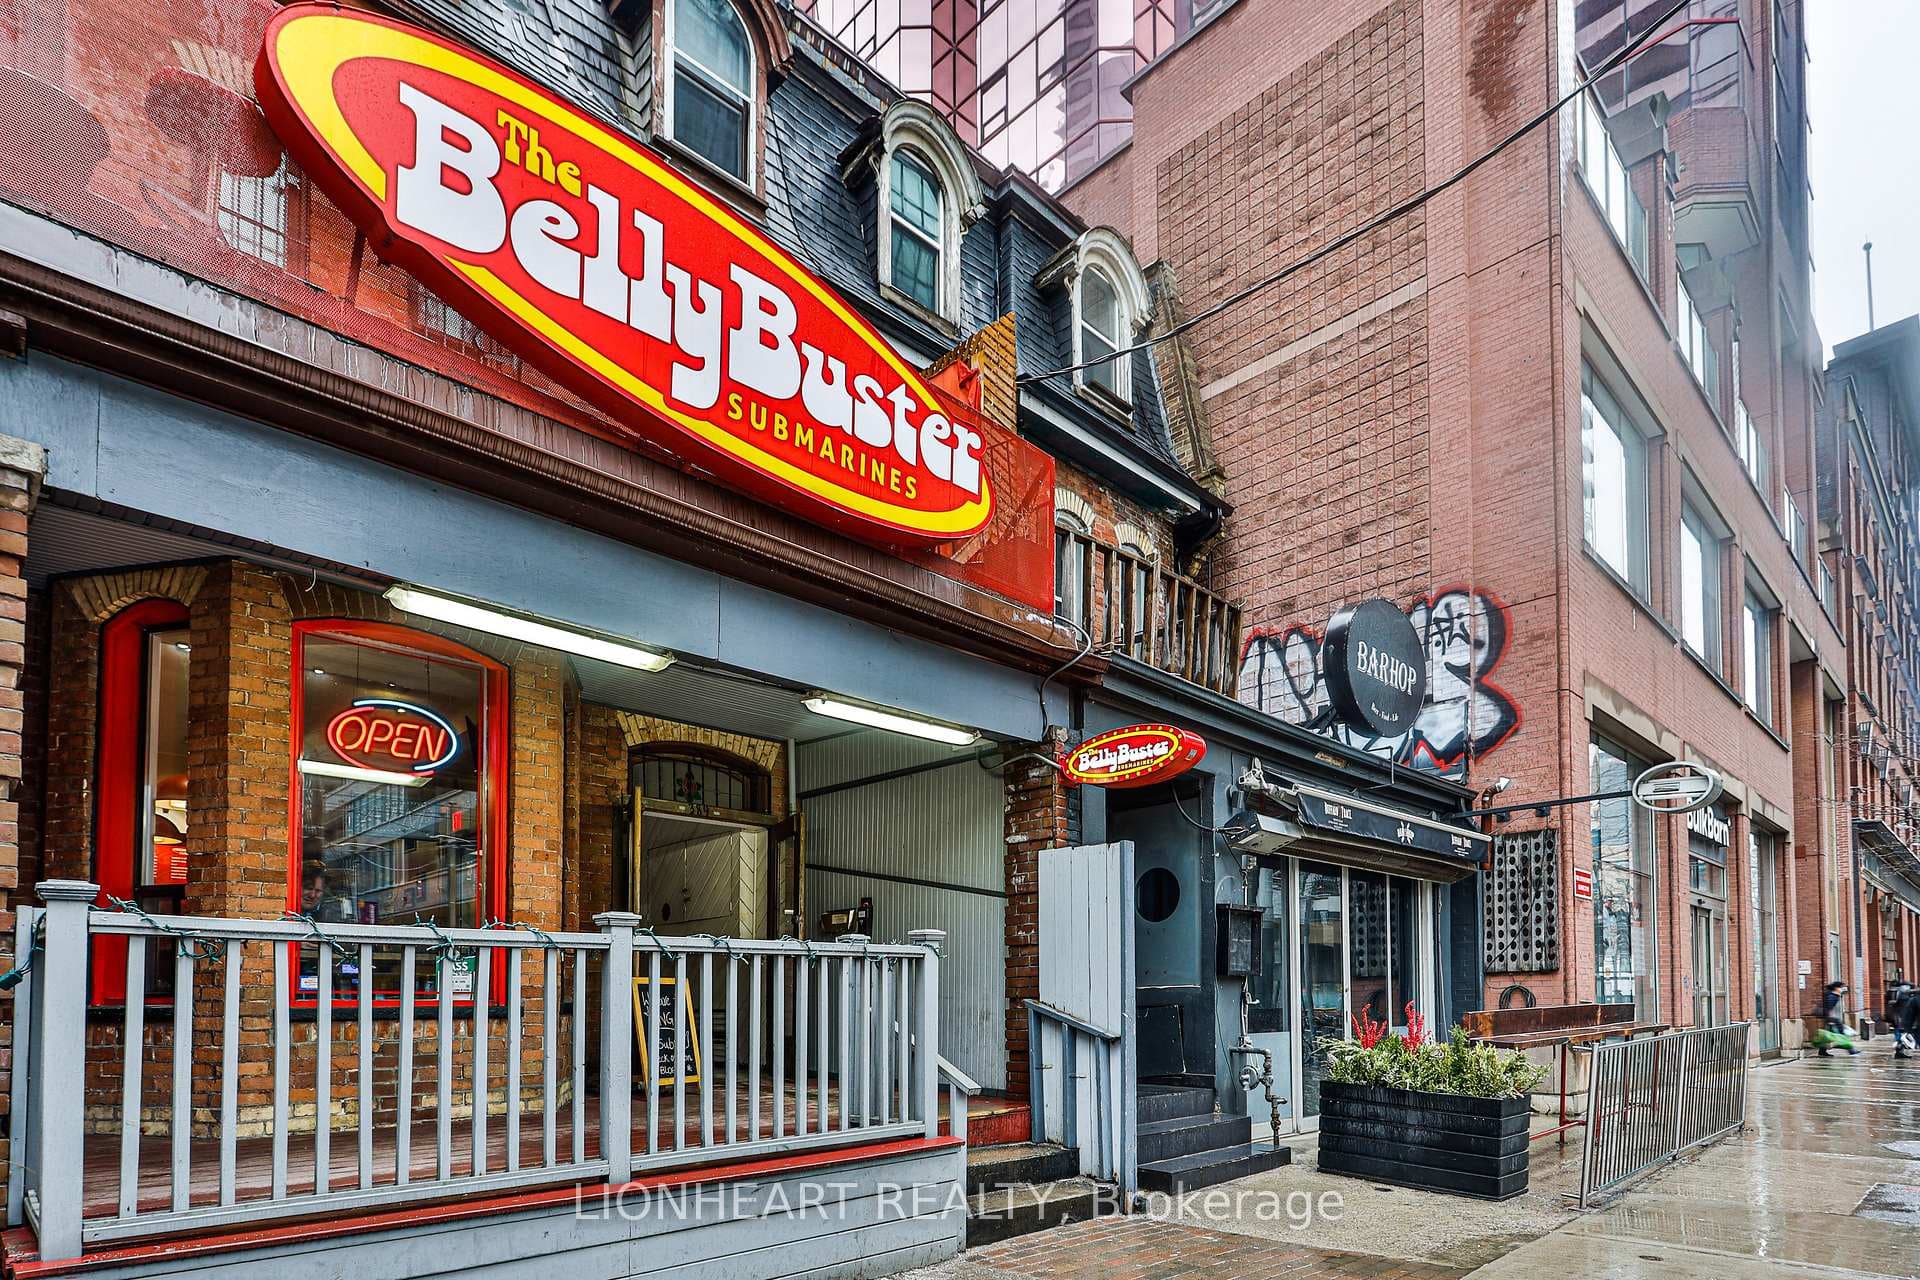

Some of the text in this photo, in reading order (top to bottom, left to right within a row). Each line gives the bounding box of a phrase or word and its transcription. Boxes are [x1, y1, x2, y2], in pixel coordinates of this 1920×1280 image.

[497, 108, 583, 198] The
[726, 391, 919, 501] SUBMARINES
[1356, 640, 1418, 696] BARHOP
[335, 715, 446, 761] OPEN
